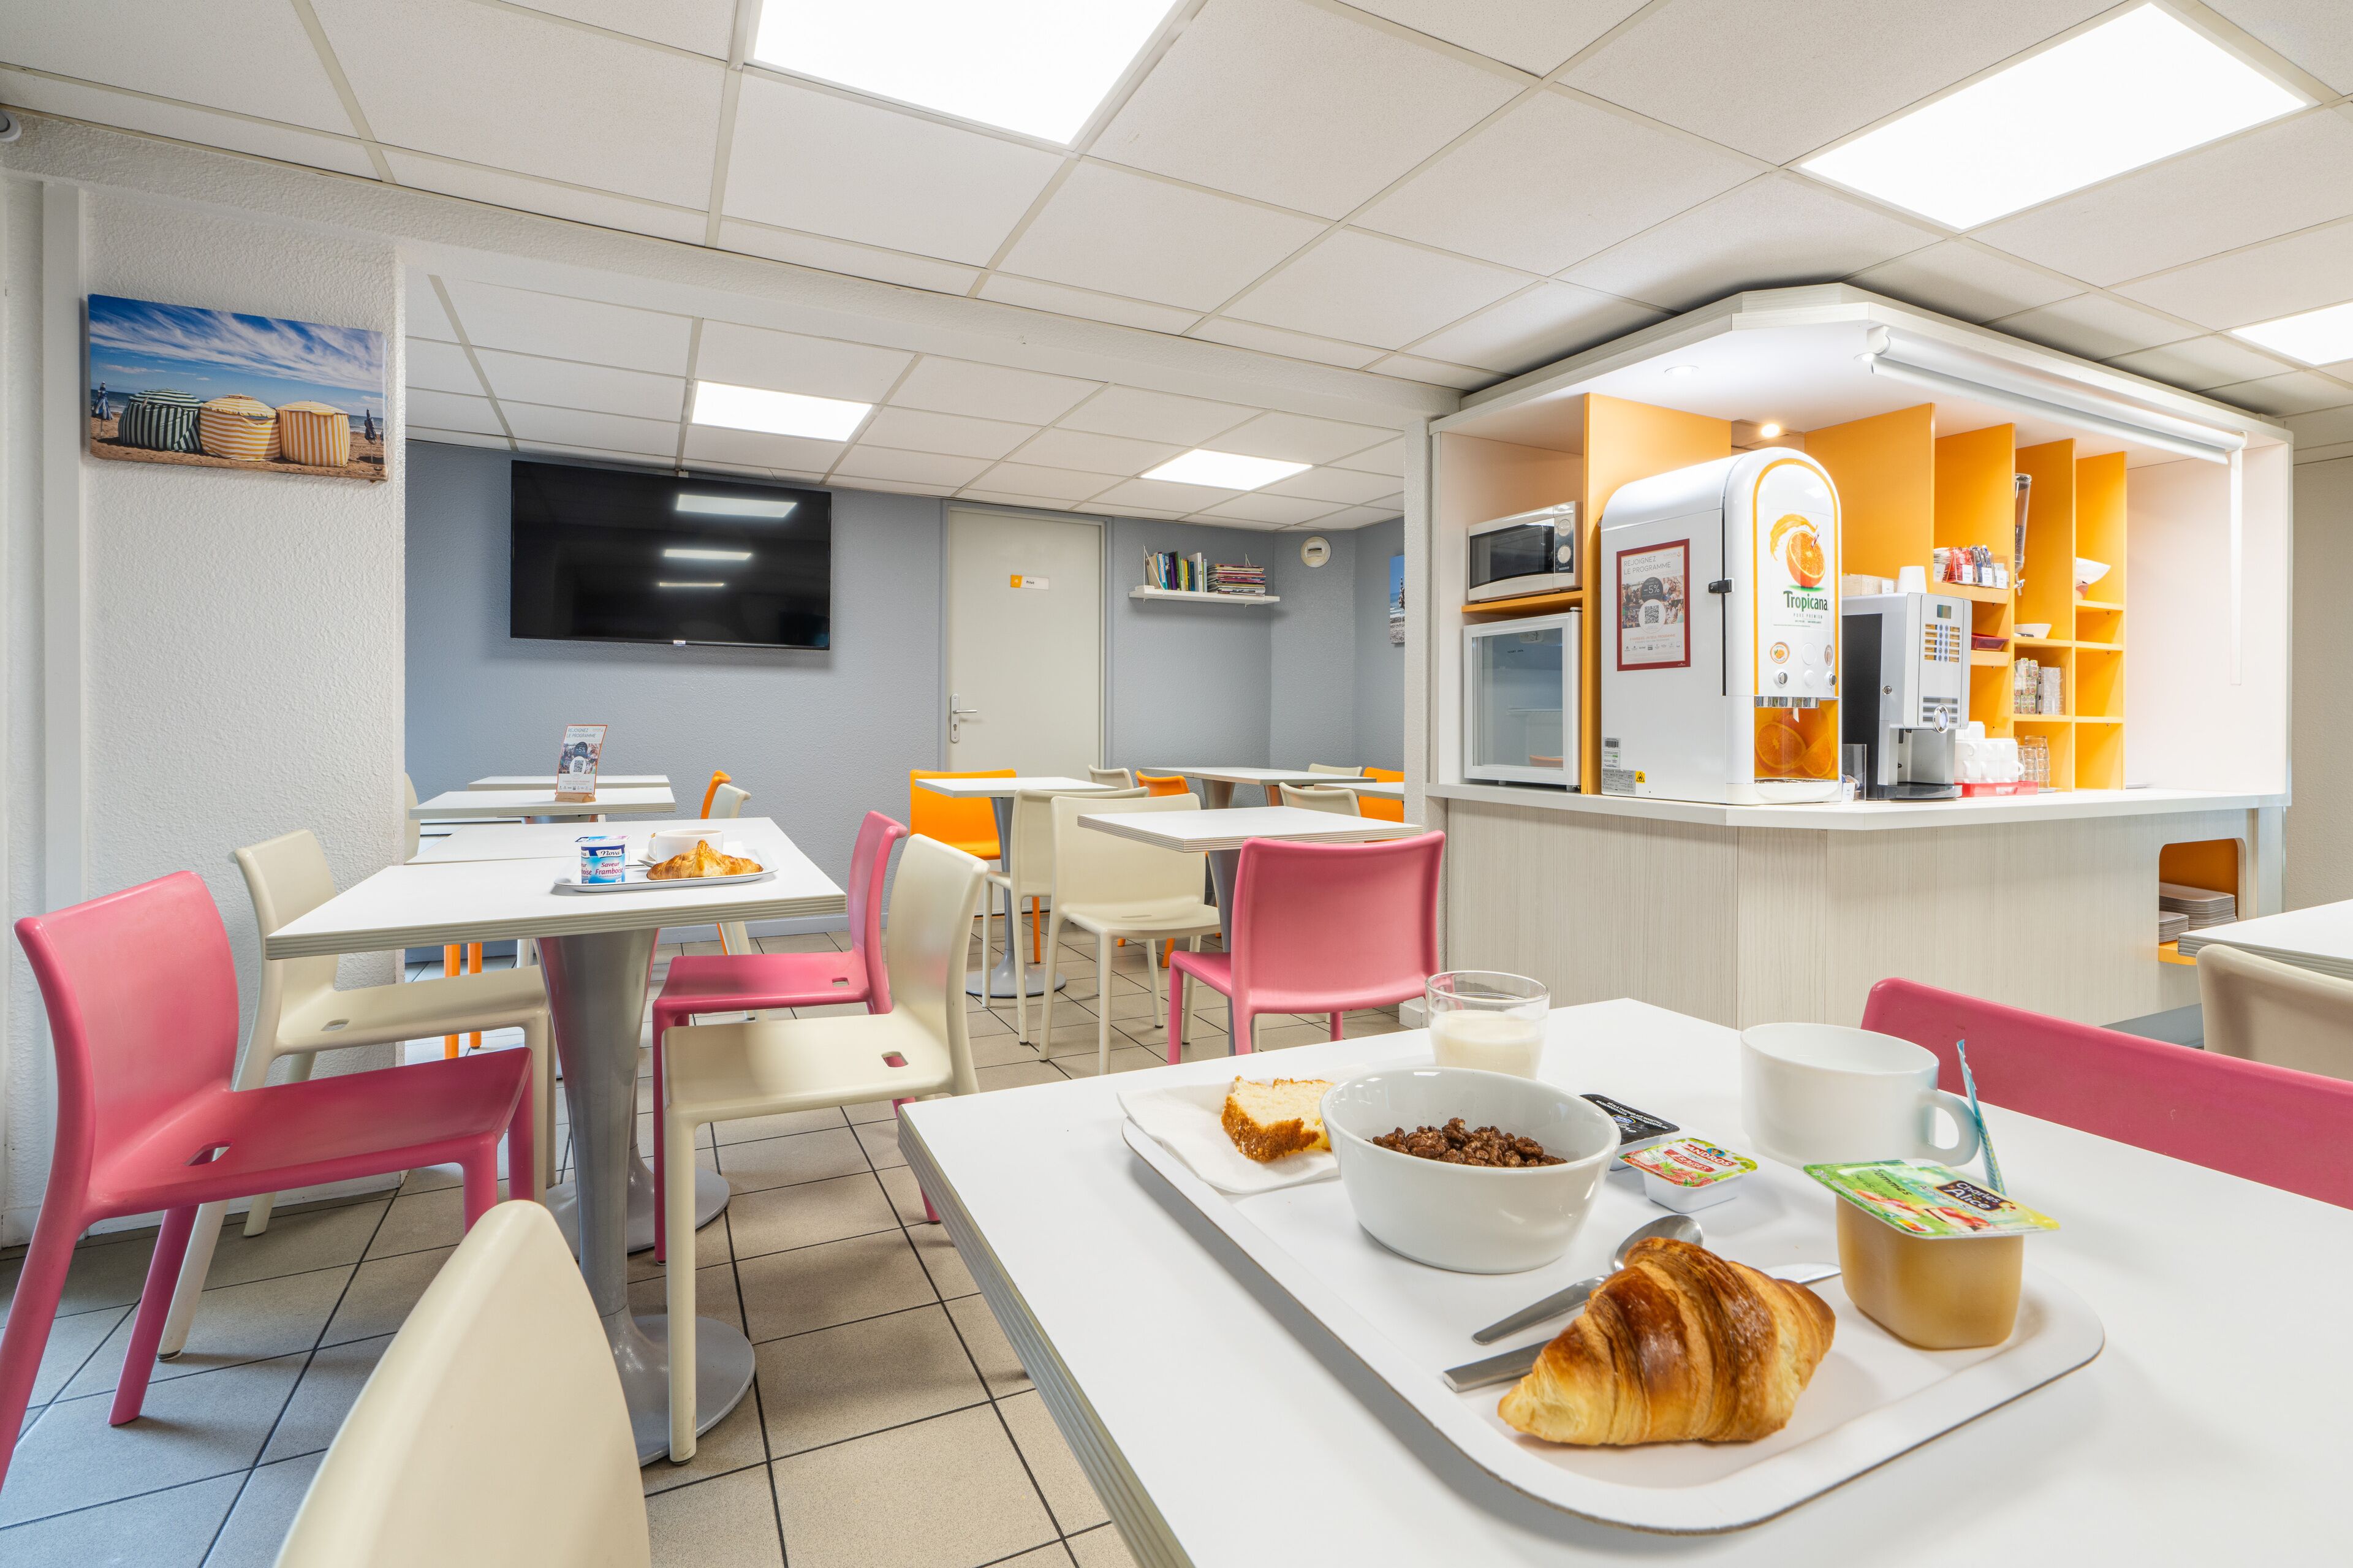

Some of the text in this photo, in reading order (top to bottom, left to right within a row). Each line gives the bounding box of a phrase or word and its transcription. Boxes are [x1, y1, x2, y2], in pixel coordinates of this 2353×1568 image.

[1623, 555, 1657, 567] REJOIGNEZ
[1632, 561, 1672, 574] PROGRAMME
[1643, 584, 1660, 594] -5%
[1783, 590, 1828, 612] Tropicana
[1672, 1154, 1710, 1170] FRAISES
[1687, 1145, 1732, 1167] ANDROS
[1944, 1189, 1991, 1210] Alice
[1957, 1183, 2001, 1203] Charles
